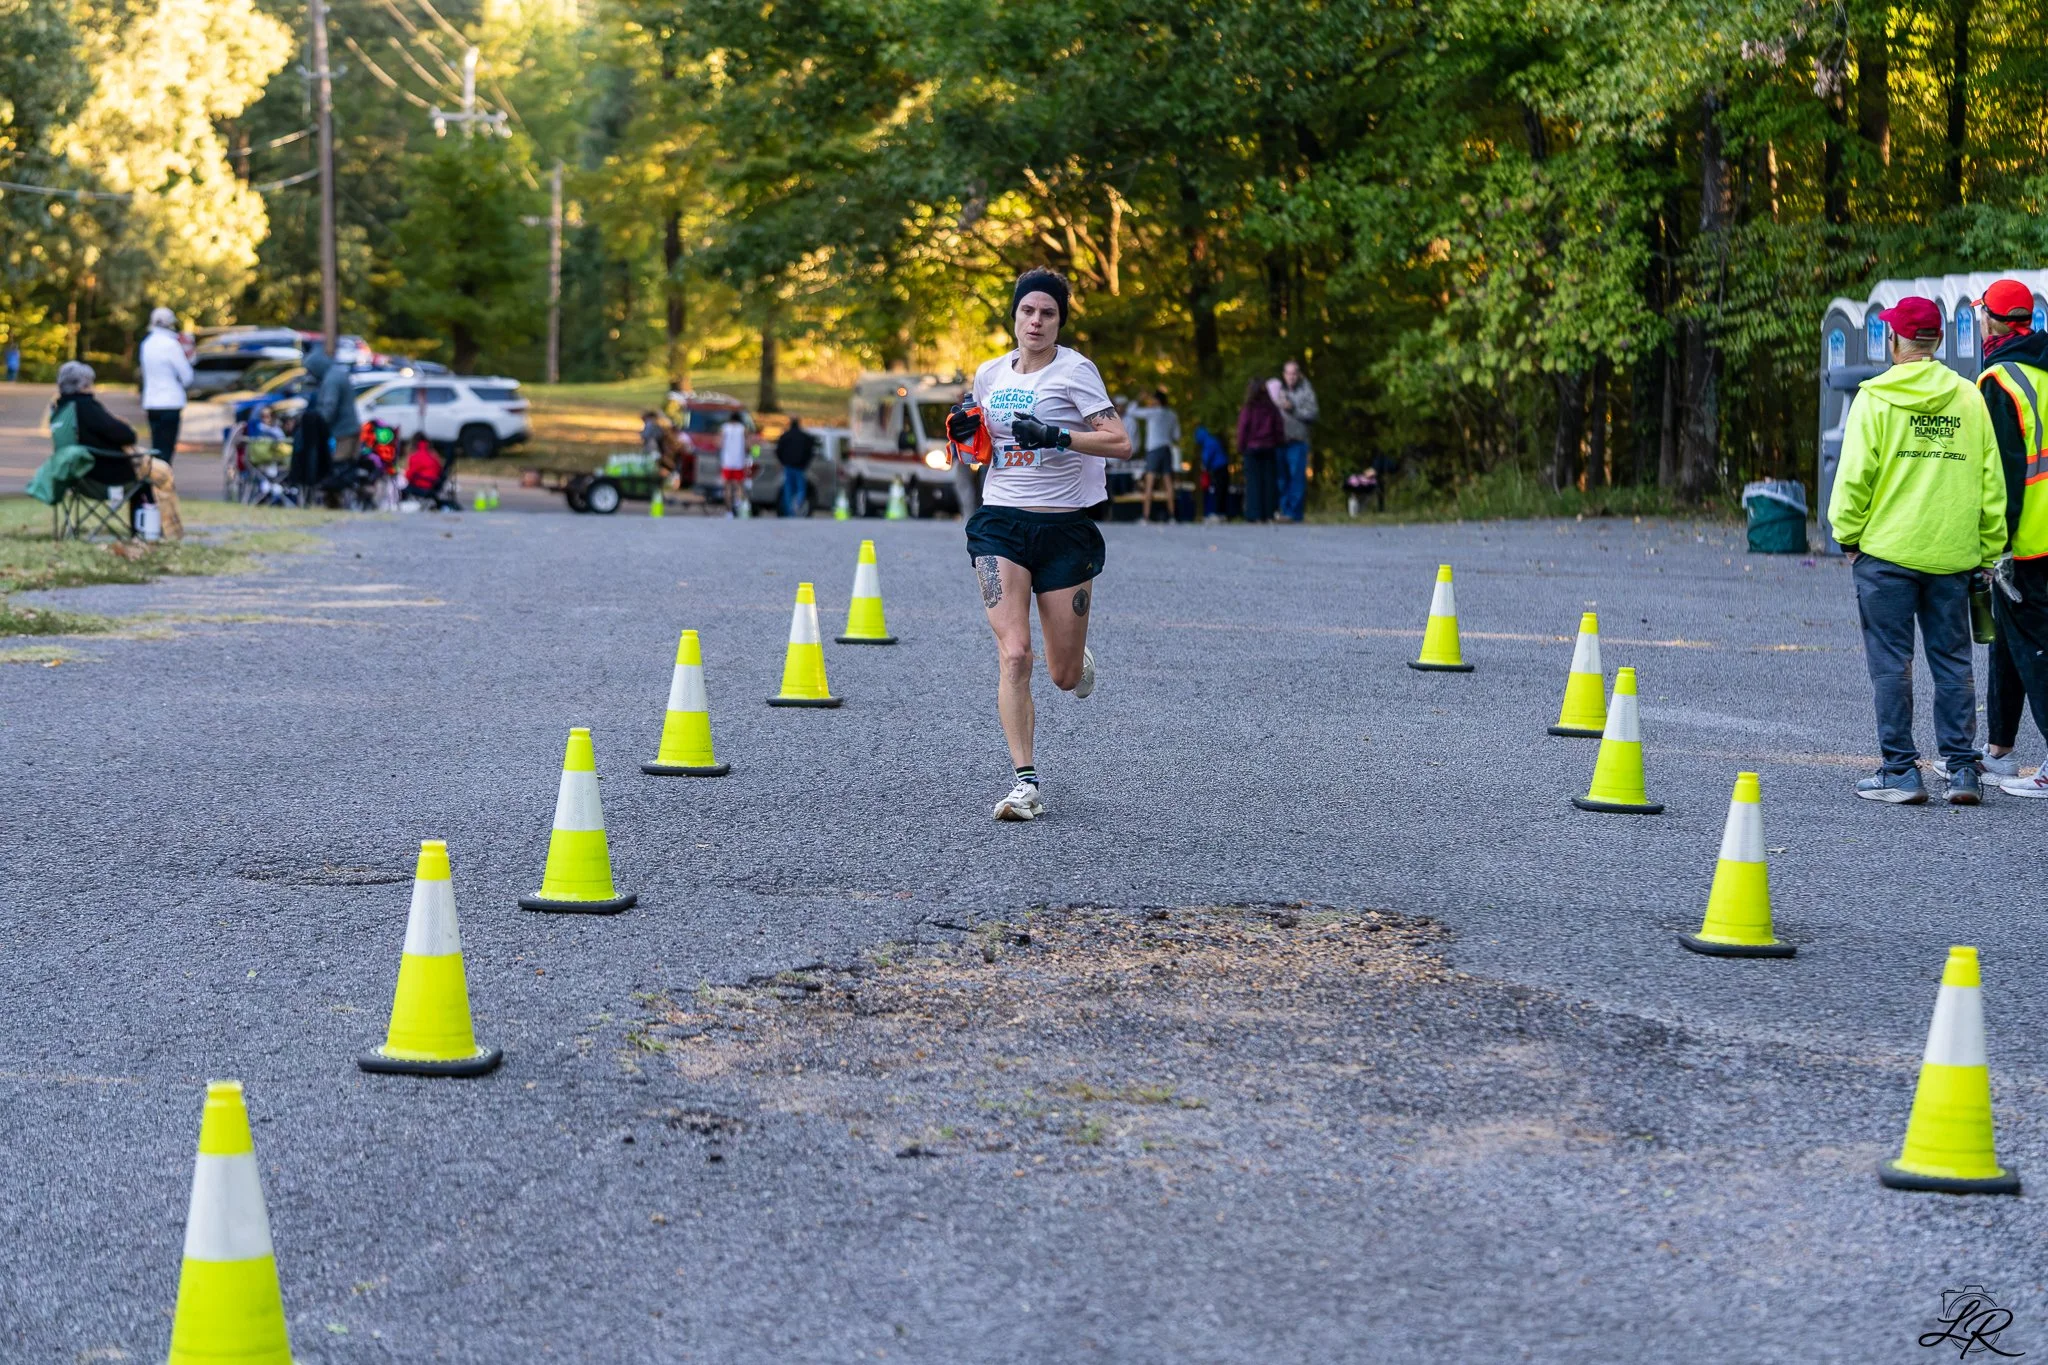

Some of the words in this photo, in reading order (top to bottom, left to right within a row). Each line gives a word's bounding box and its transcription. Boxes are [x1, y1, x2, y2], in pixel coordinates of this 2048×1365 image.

[990, 393, 1033, 404] CHICAGO
[1910, 415, 1961, 428] MEMPHIS
[1914, 426, 1955, 436] RUNNERS
[1004, 451, 1035, 466] 229
[1922, 450, 1942, 458] LINE
[1943, 451, 1967, 461] CREW
